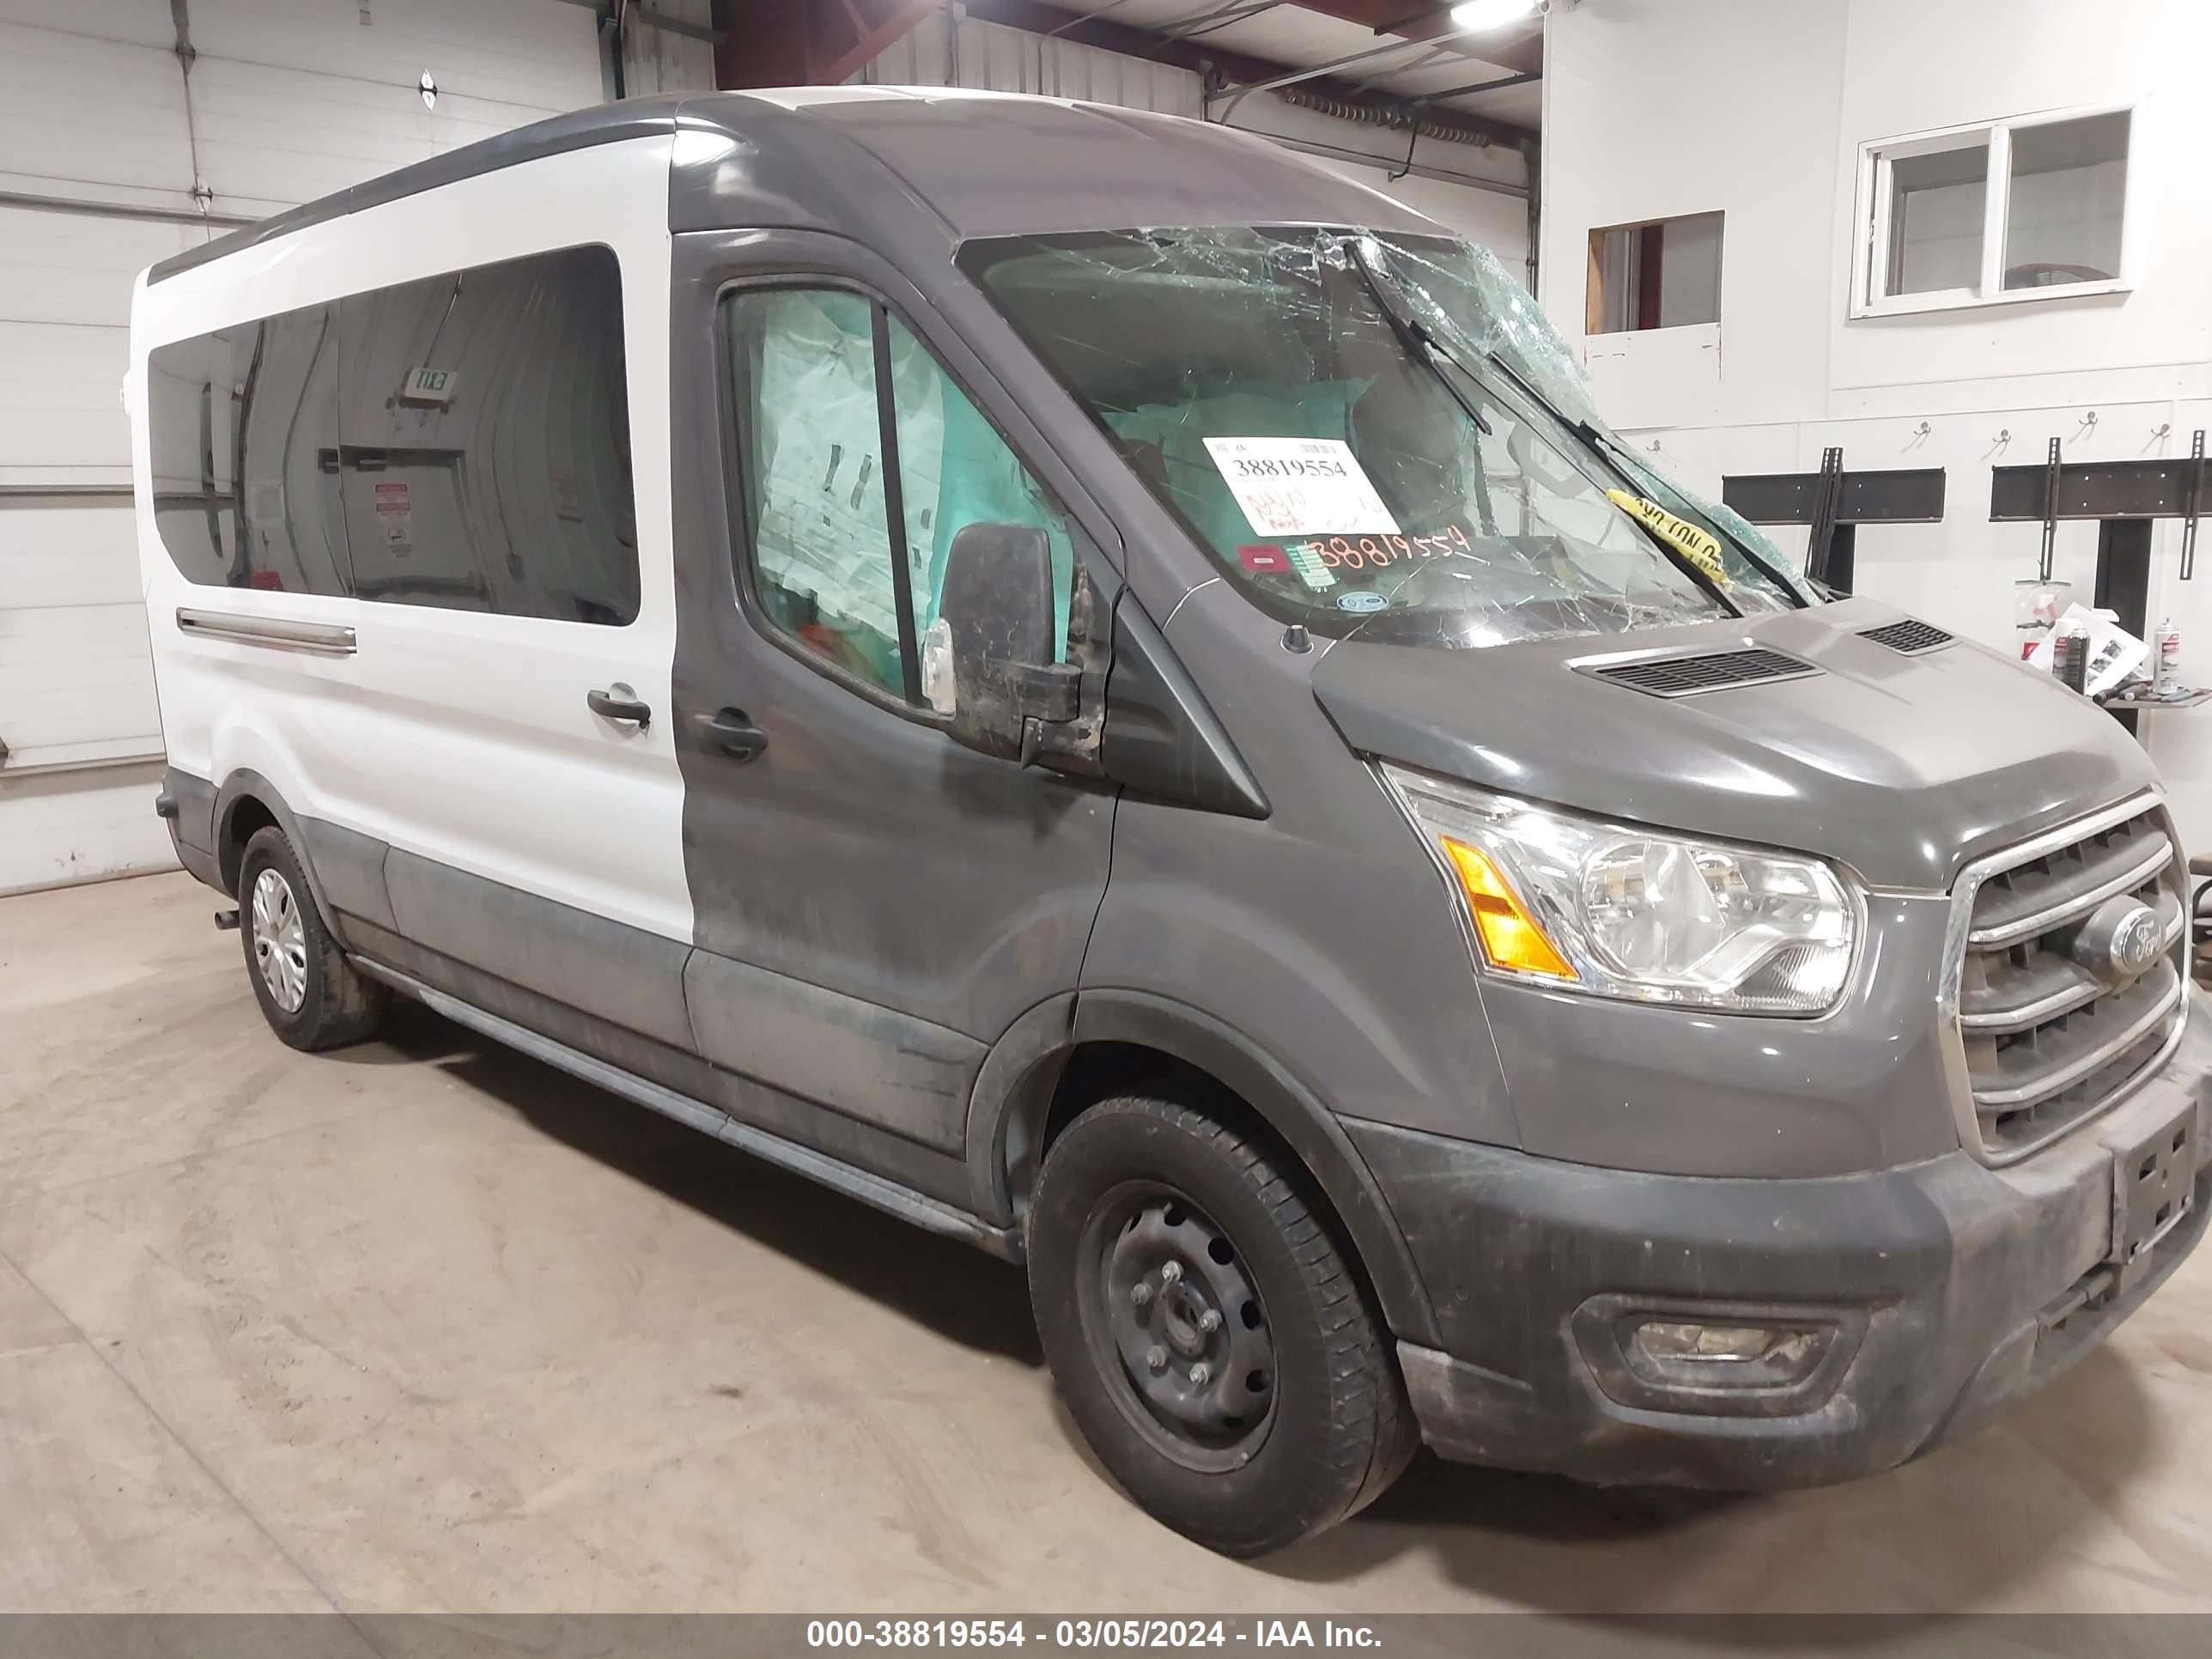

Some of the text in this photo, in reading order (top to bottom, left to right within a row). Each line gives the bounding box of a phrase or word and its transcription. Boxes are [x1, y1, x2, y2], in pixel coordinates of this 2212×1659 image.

[1232, 459, 1347, 477] 38819554
[1306, 525, 1471, 569] 38819554
[2136, 920, 2162, 963] Ford
